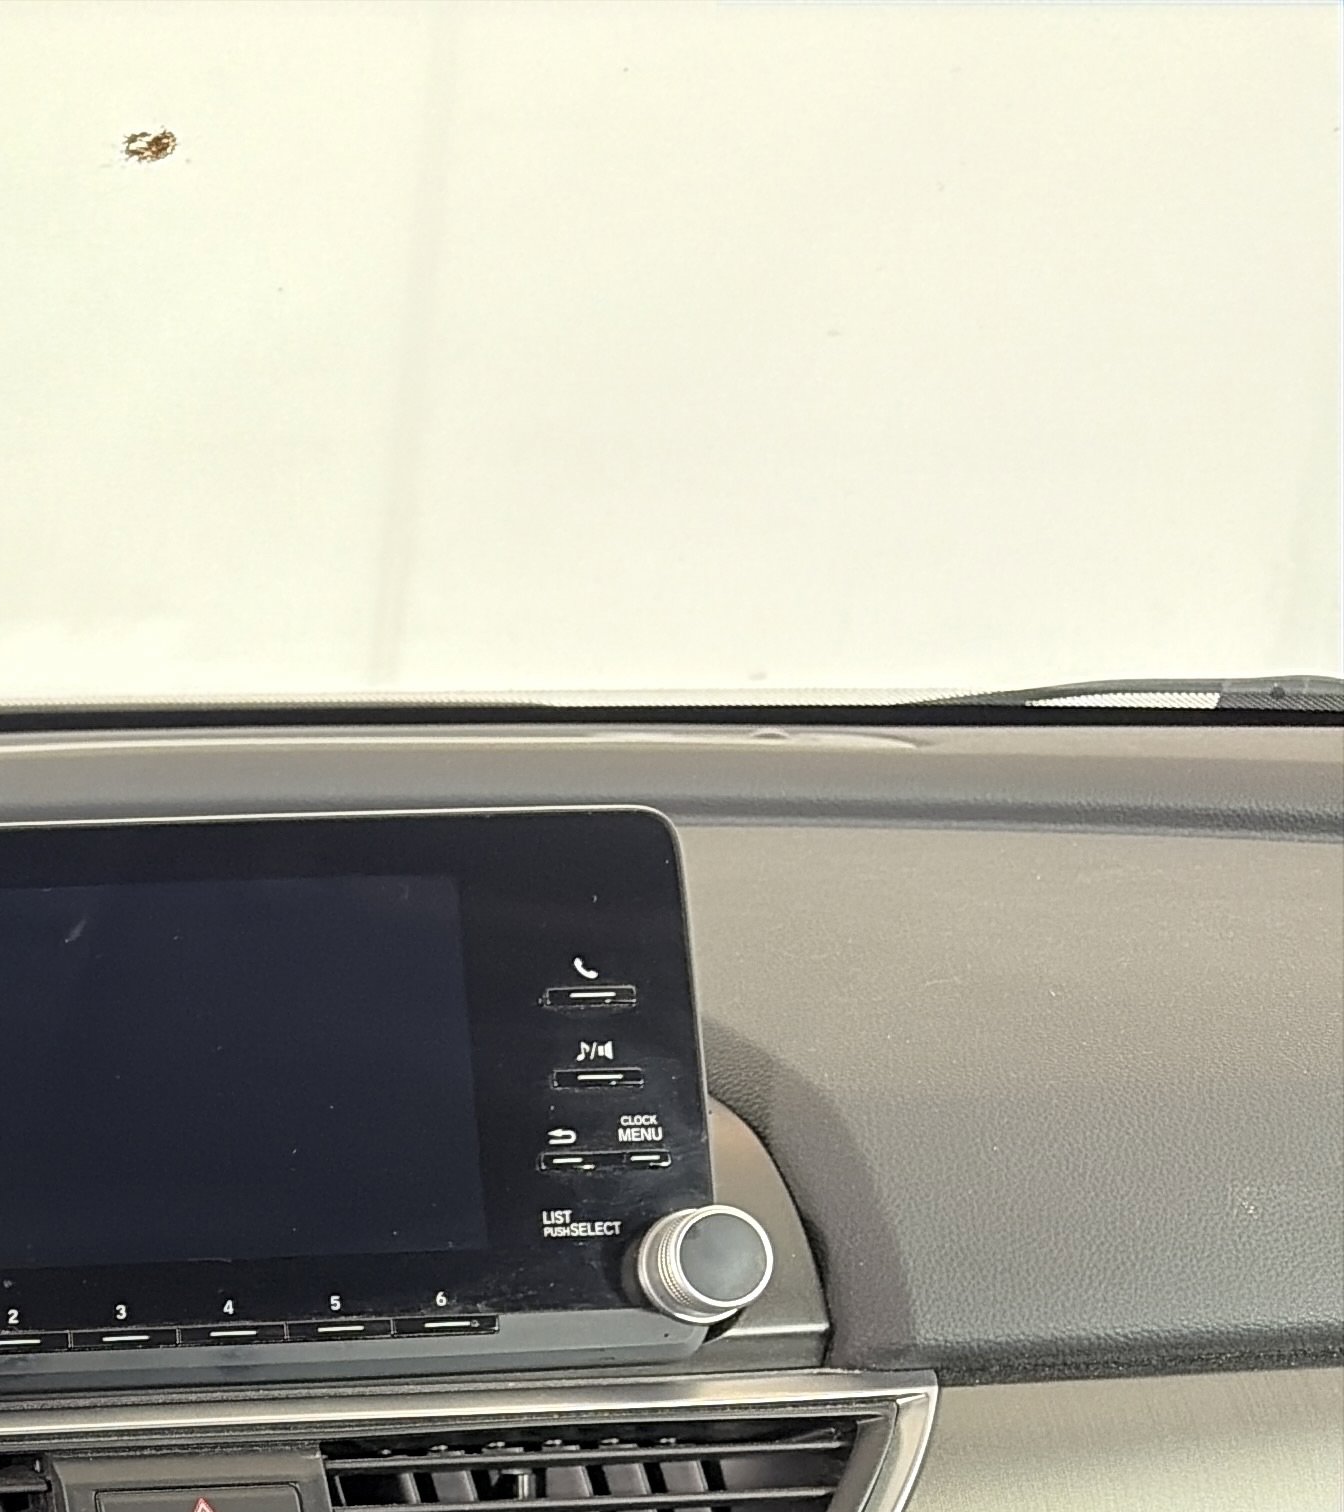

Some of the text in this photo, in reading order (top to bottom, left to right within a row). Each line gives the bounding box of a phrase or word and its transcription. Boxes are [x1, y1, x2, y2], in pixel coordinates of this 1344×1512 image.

[620, 1114, 657, 1126] CLOCK
[618, 1126, 663, 1142] MENU
[542, 1209, 572, 1225] LIST
[543, 1220, 622, 1238] PUSH SELECT
[330, 1295, 341, 1311] 5
[435, 1291, 447, 1307] 6
[115, 1304, 127, 1320] 3
[223, 1300, 234, 1315] 4
[7, 1309, 19, 1324] 2
